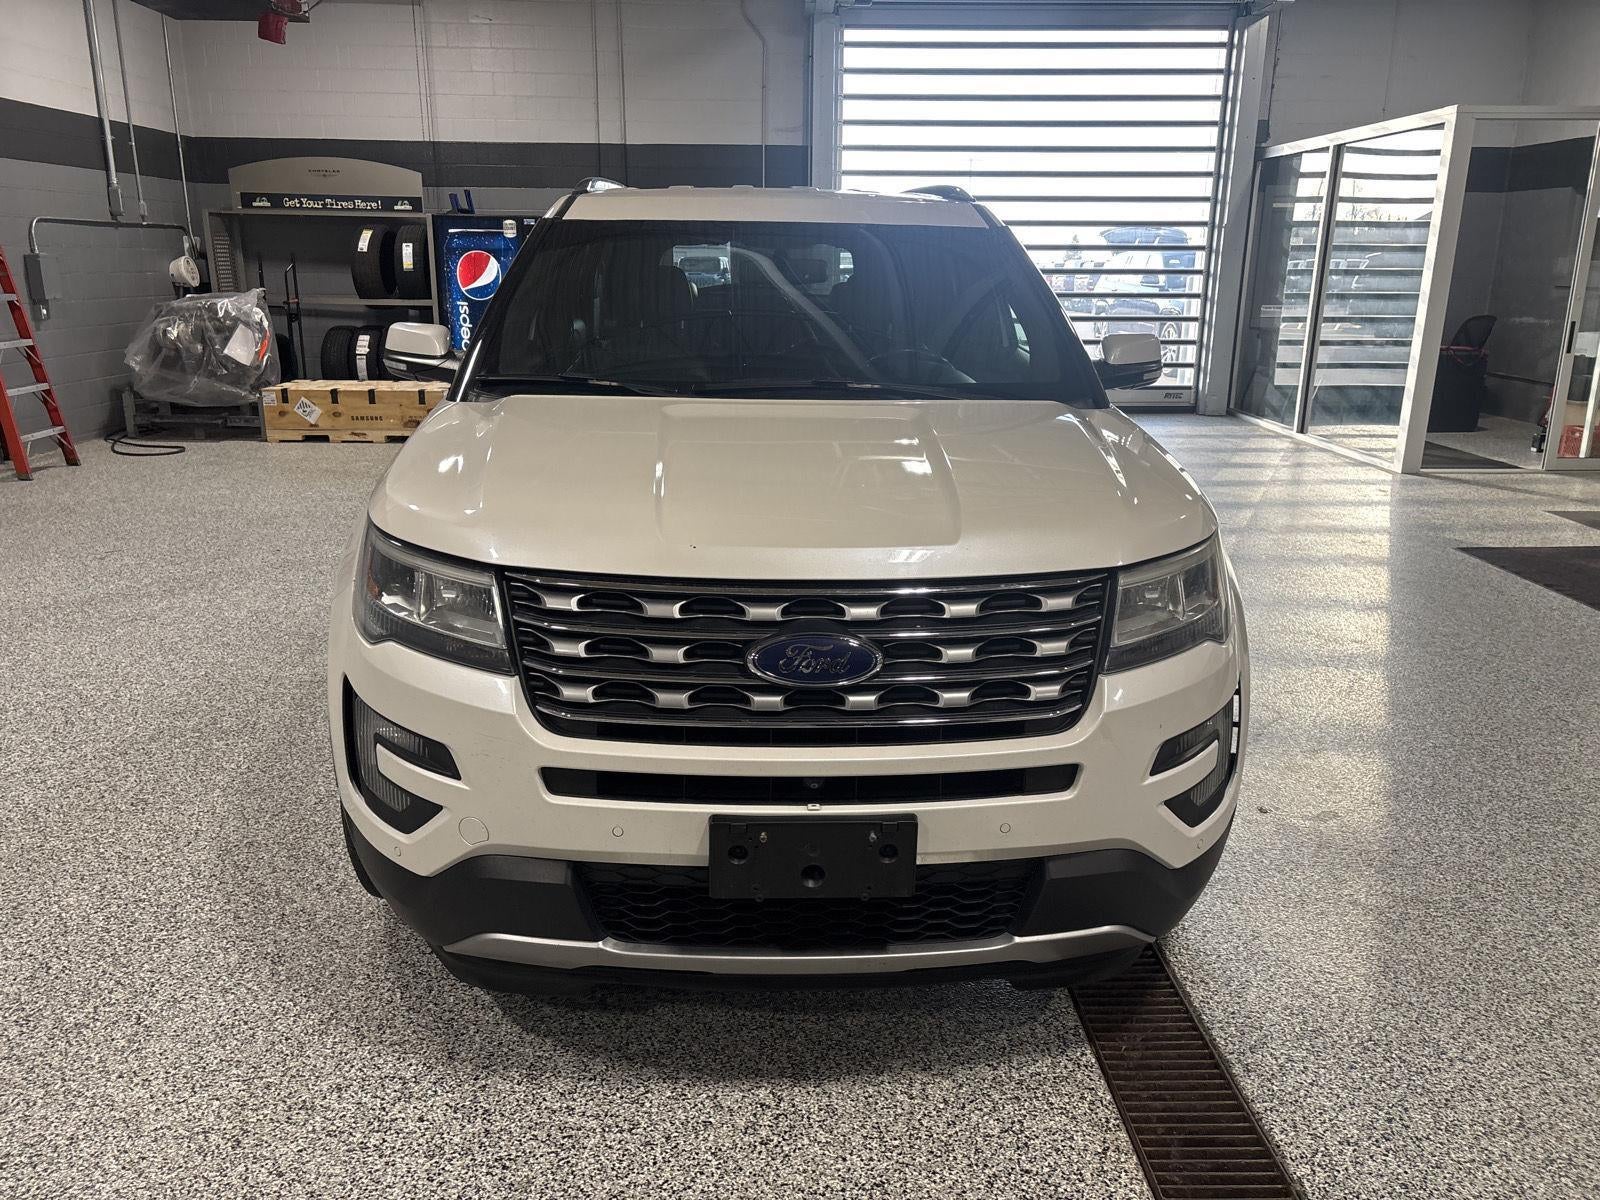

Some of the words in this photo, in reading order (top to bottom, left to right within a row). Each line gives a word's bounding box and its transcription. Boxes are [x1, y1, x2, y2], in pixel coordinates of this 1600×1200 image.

[283, 198, 300, 207] Get
[301, 198, 324, 208] Your
[325, 198, 354, 209] Tires
[354, 199, 382, 209] Here!
[778, 643, 851, 674] Ford
